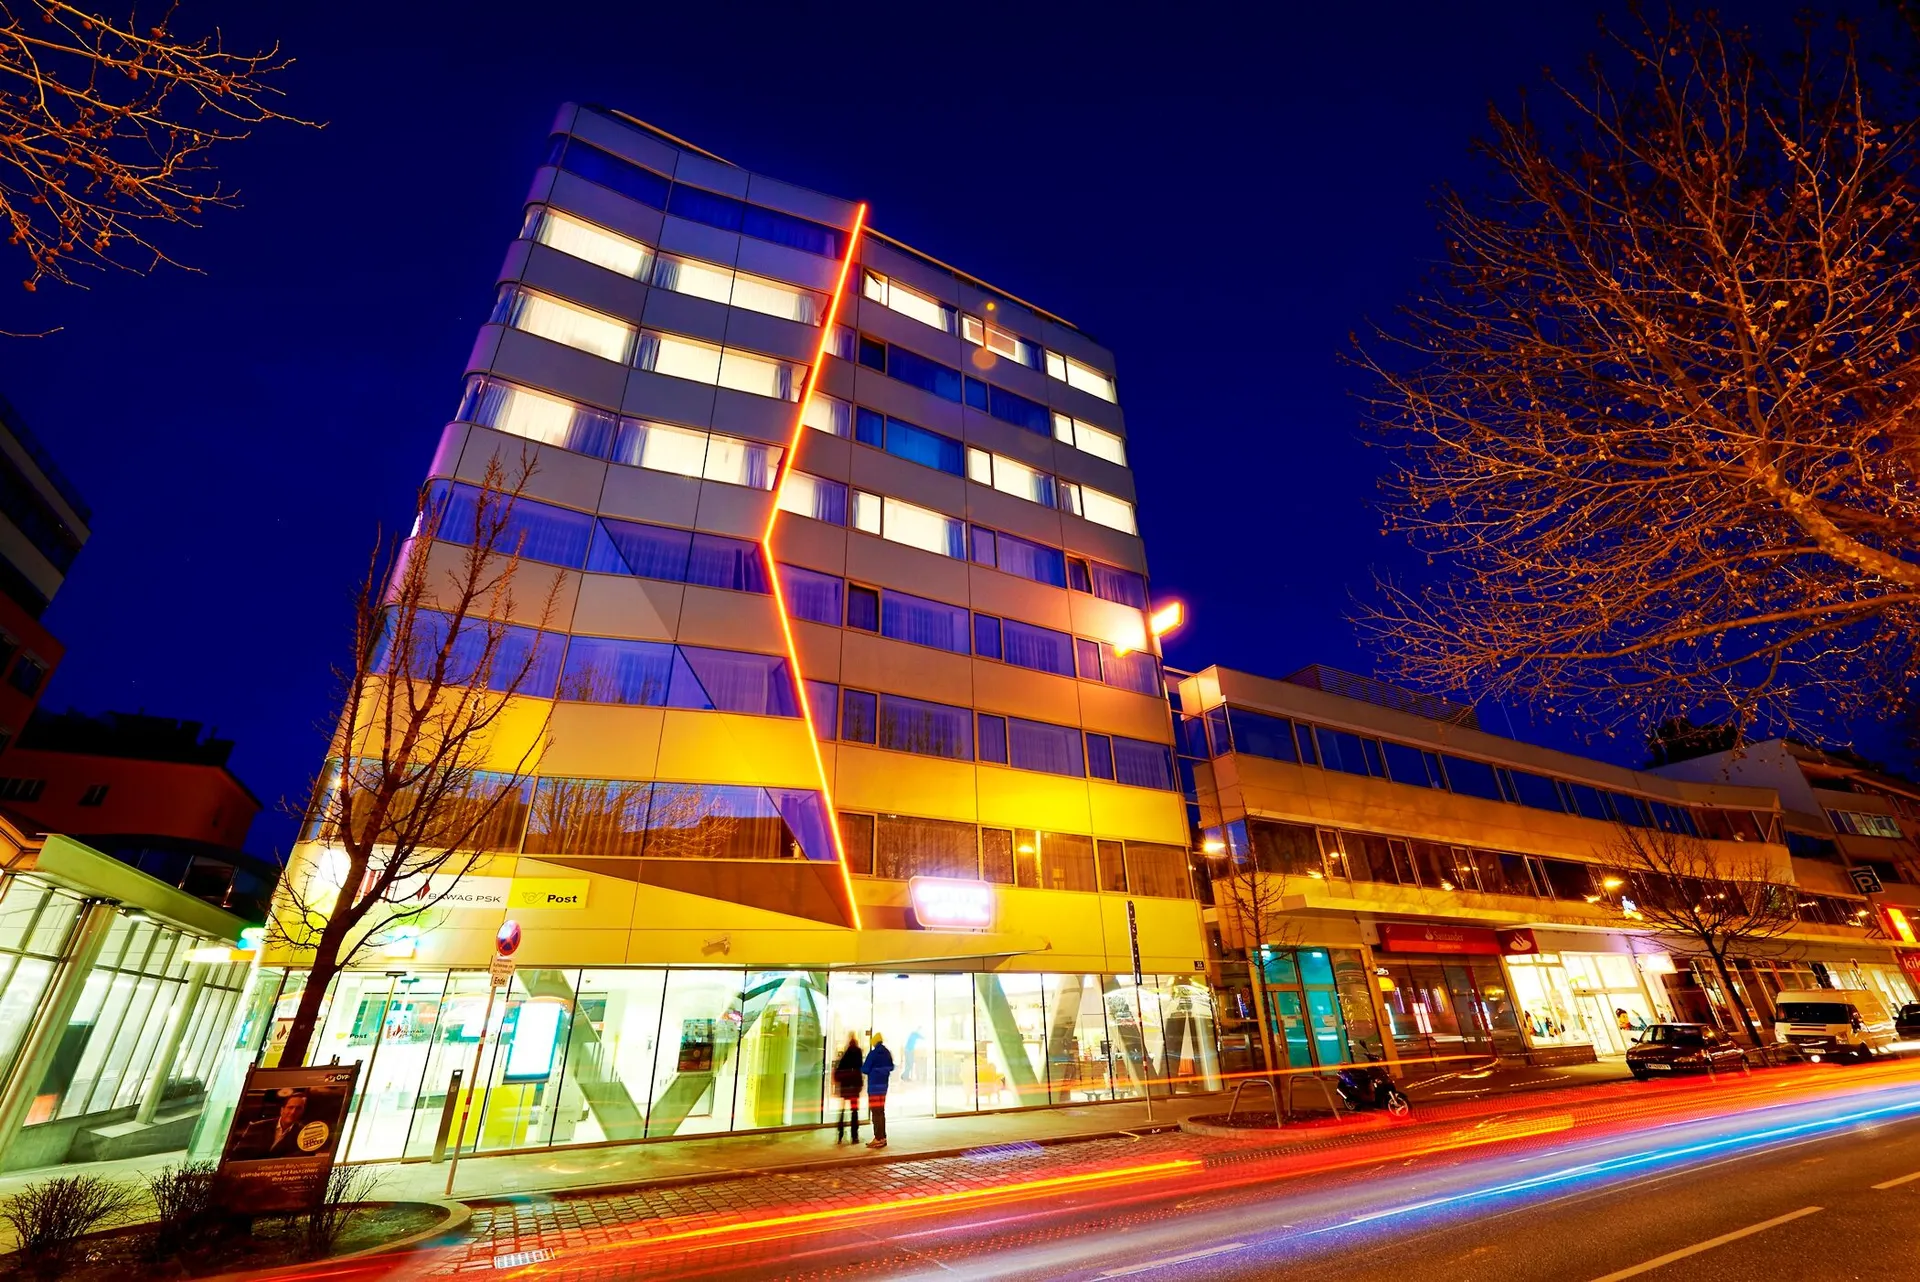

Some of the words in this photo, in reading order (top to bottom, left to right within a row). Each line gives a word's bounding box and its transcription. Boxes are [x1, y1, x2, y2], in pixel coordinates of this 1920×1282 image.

[428, 892, 473, 902] BAWAG
[475, 895, 501, 903] PSK
[547, 894, 578, 904] Post
[1433, 930, 1464, 942] Santander
